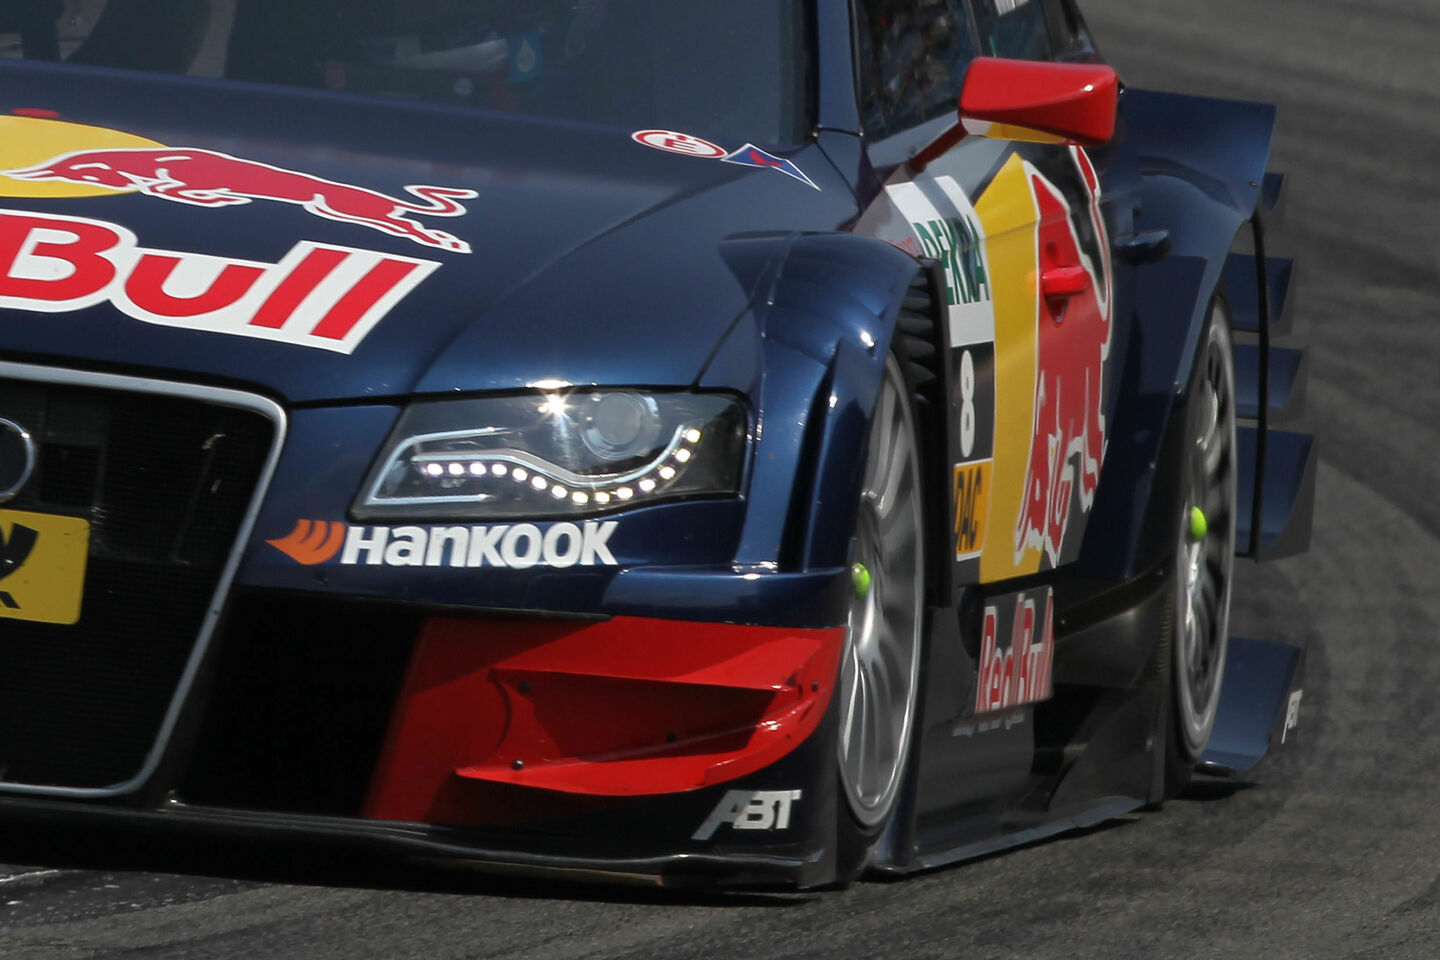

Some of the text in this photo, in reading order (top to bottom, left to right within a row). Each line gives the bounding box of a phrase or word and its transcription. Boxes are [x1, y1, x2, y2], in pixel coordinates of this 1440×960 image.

[960, 349, 976, 458] 8
[340, 521, 619, 569] Hankook
[690, 788, 804, 841] ABT
